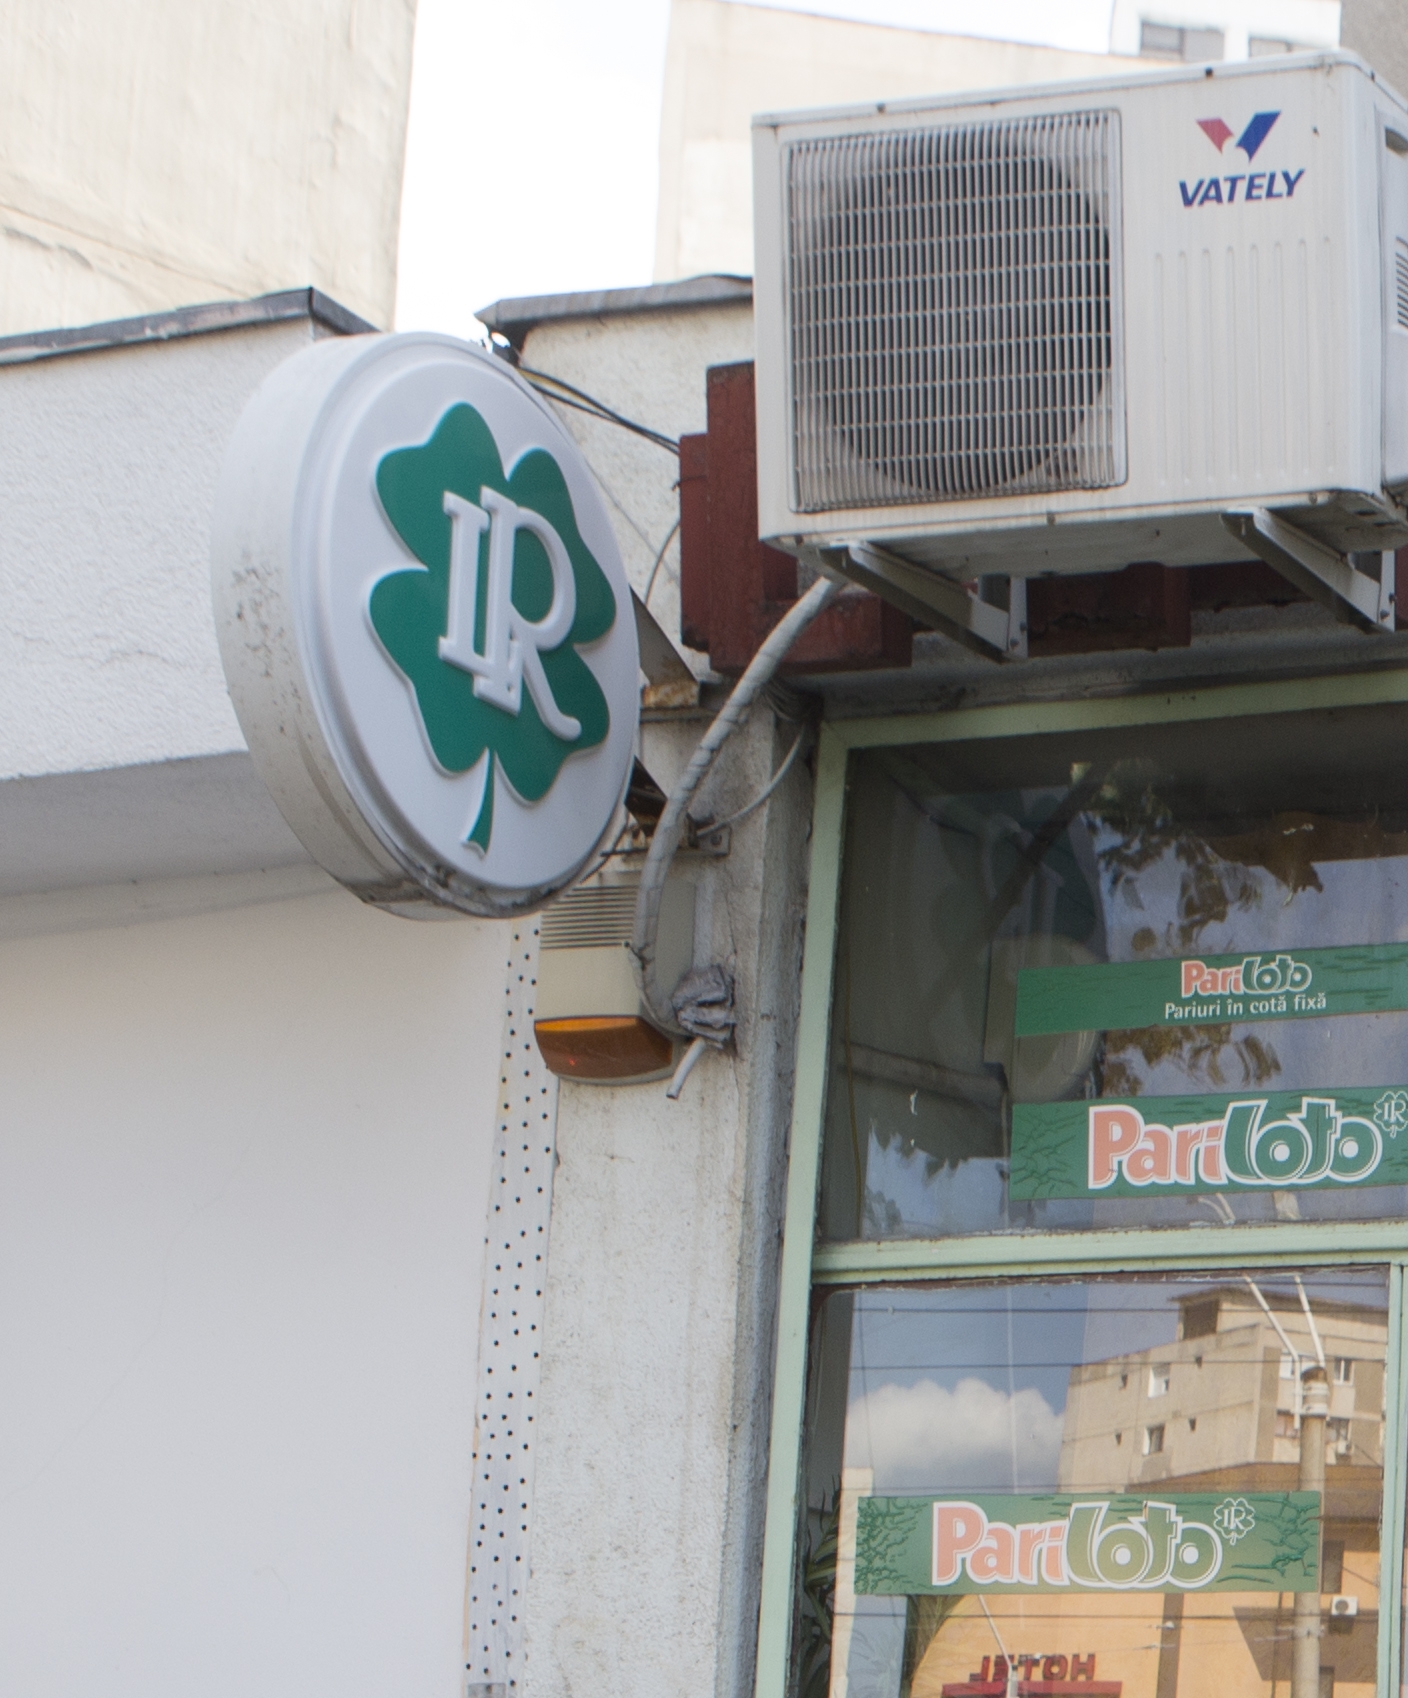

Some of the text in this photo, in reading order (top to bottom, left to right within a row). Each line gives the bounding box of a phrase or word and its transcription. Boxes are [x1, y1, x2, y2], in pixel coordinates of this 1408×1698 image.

[1178, 167, 1305, 208] VATELY
[1164, 991, 1327, 1020] Pariuri în cotă fixă
